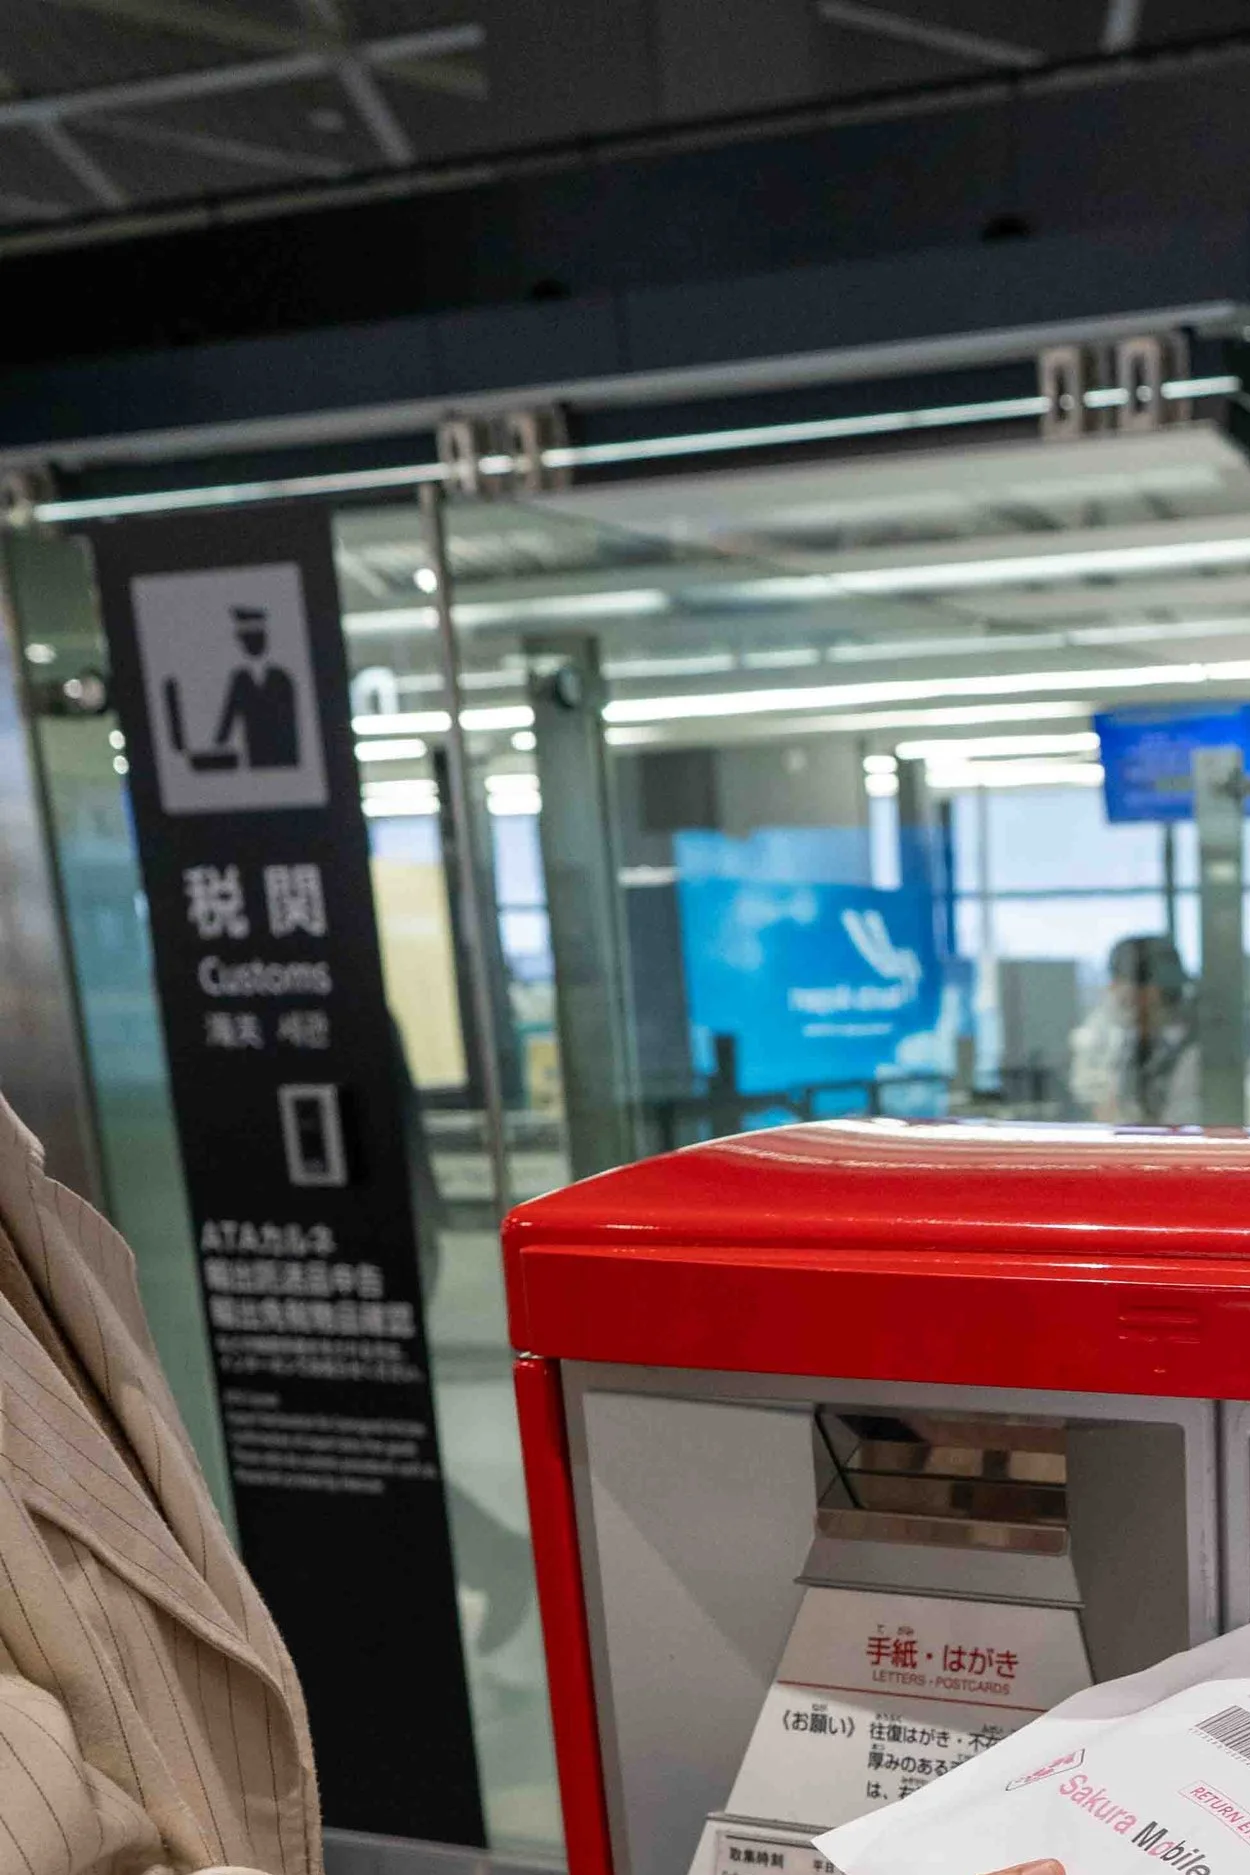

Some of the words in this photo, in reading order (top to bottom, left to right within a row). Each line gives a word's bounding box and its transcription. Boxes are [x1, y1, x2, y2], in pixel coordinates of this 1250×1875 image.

[198, 956, 333, 997] Customs
[867, 1636, 1019, 1679] 手紙・はがき
[872, 1669, 925, 1687] LETTERS
[936, 1677, 1011, 1696] POSTCARDS
[1059, 1774, 1137, 1835] Sakura
[1190, 1786, 1245, 1824] RETURN
